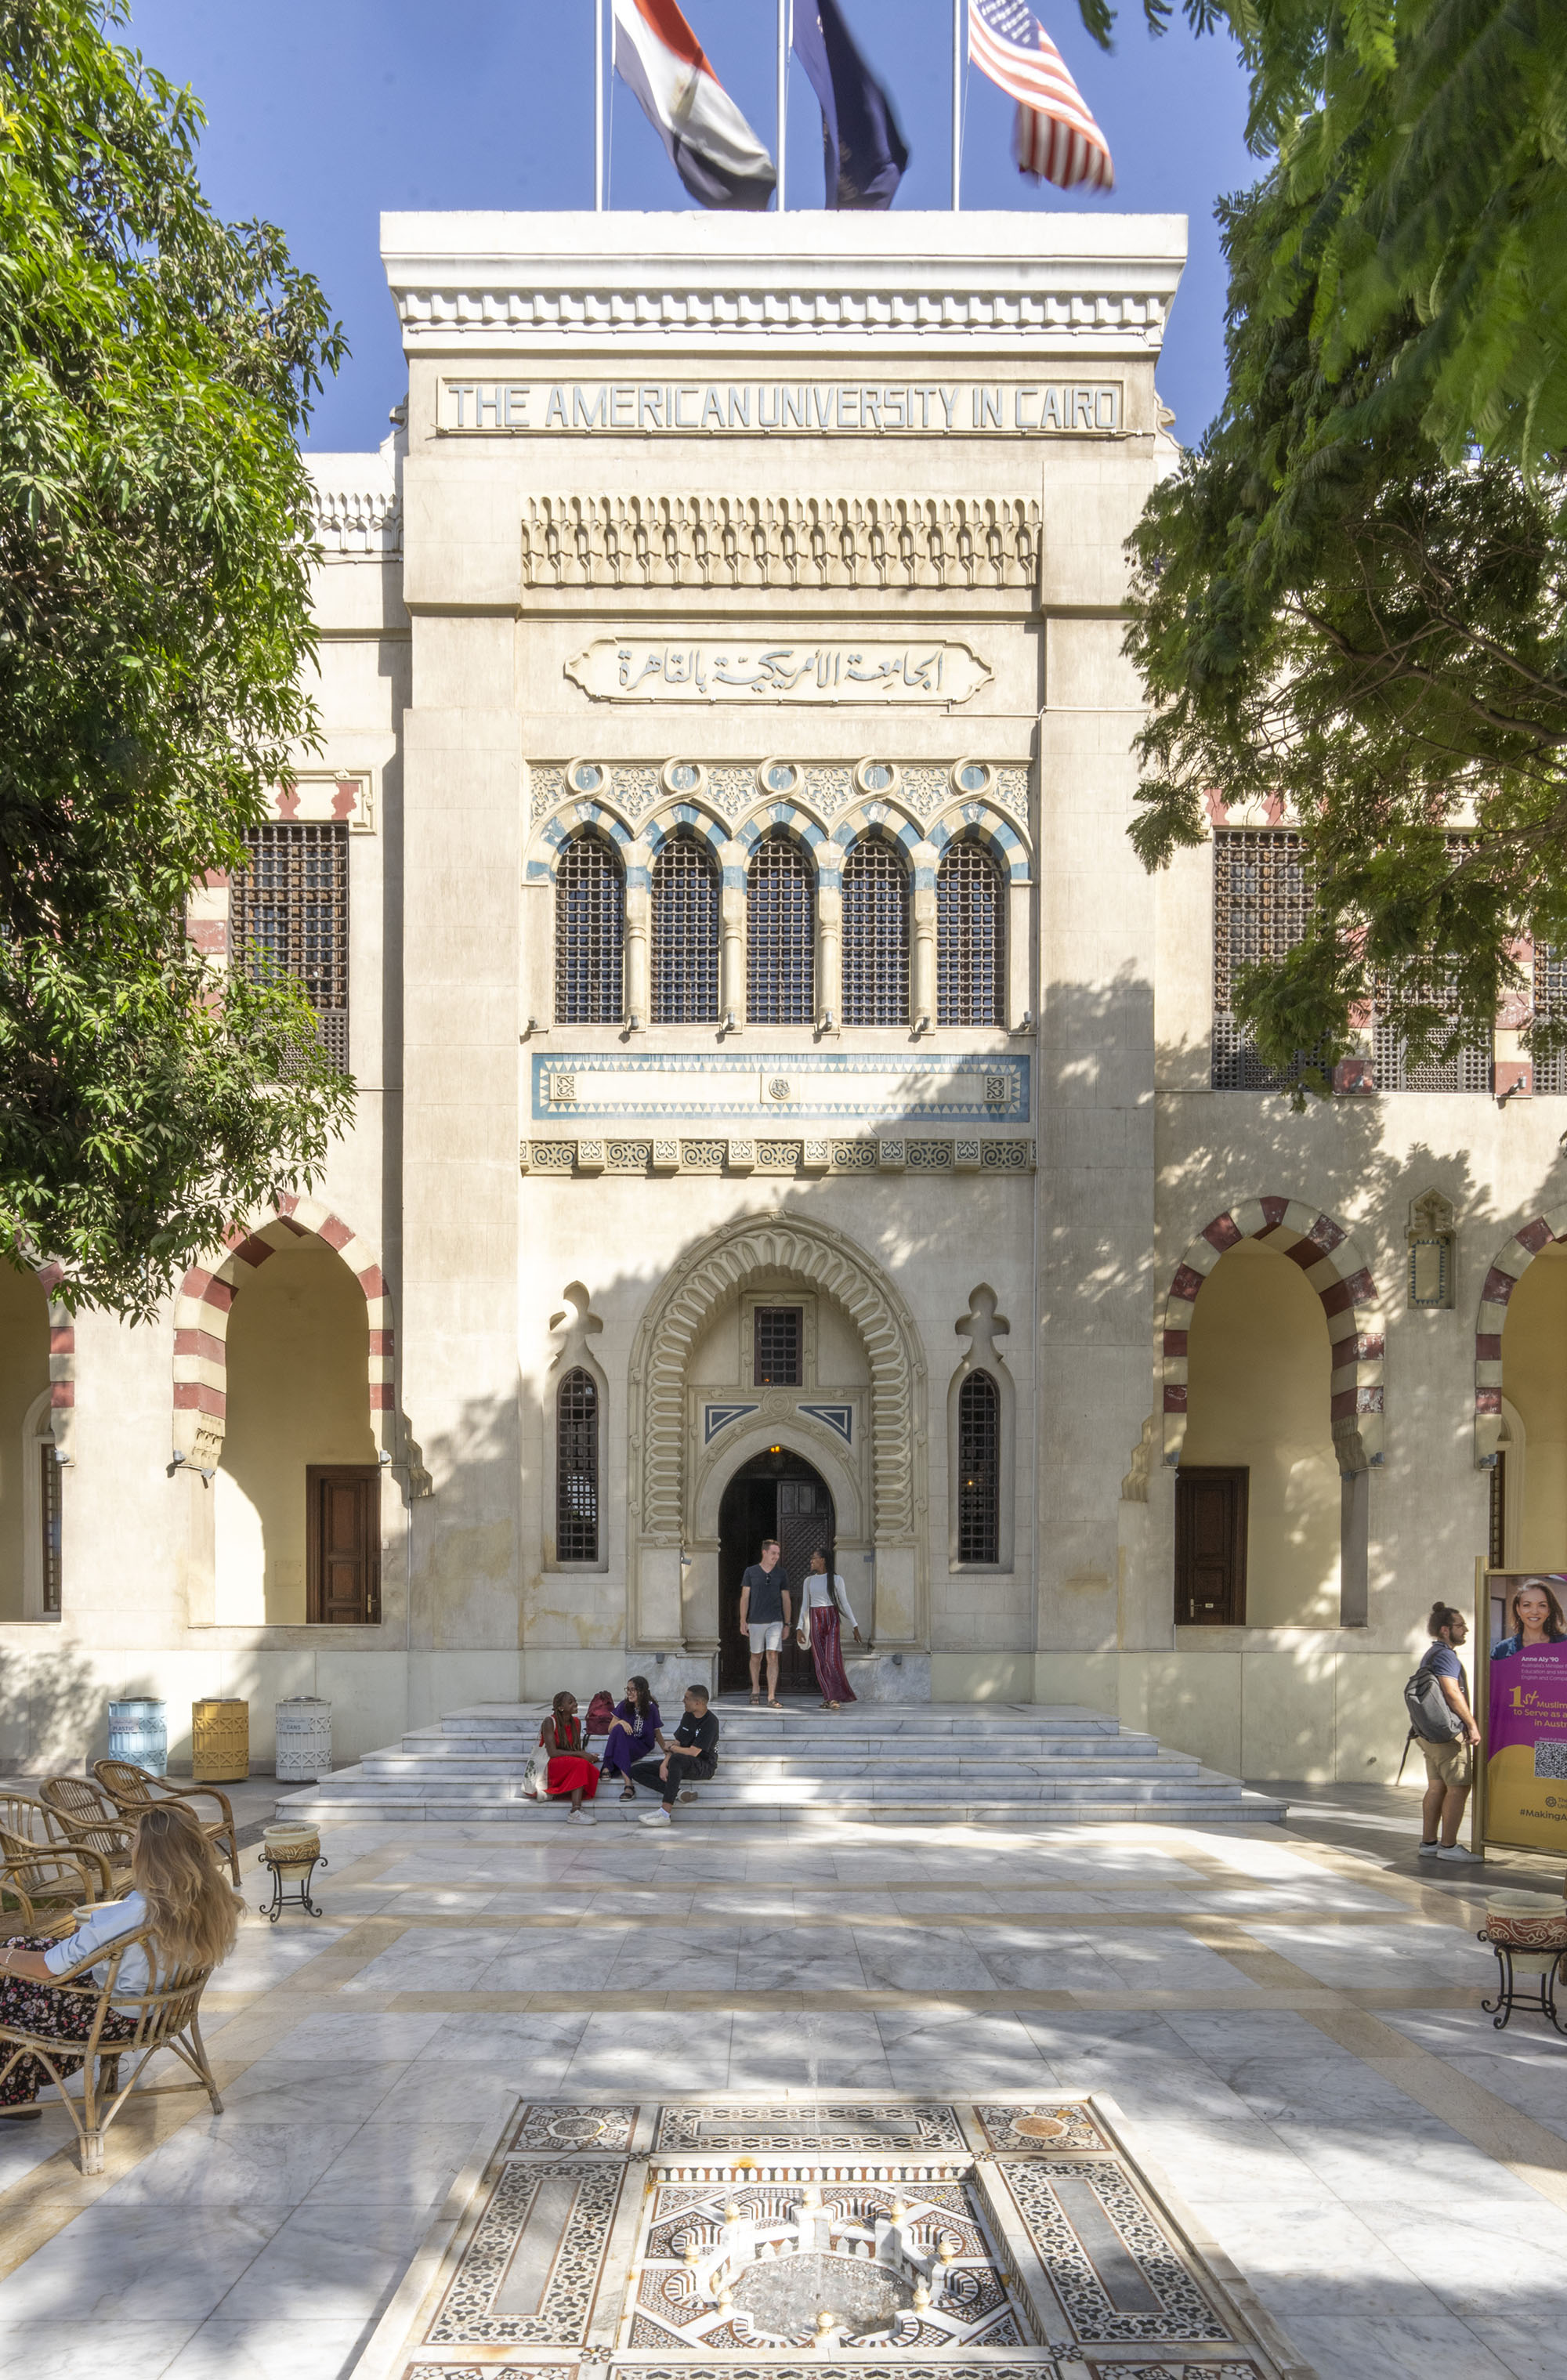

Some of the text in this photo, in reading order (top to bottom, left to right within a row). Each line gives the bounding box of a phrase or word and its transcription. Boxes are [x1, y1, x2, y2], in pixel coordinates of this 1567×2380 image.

[448, 385, 1118, 429] THE AMERICAN UNIVERSITY IN CAIRO
[617, 646, 708, 694] بالقاهرة
[1508, 1685, 1567, 1709] 1st Muslim
[1524, 1709, 1549, 1717] Serve
